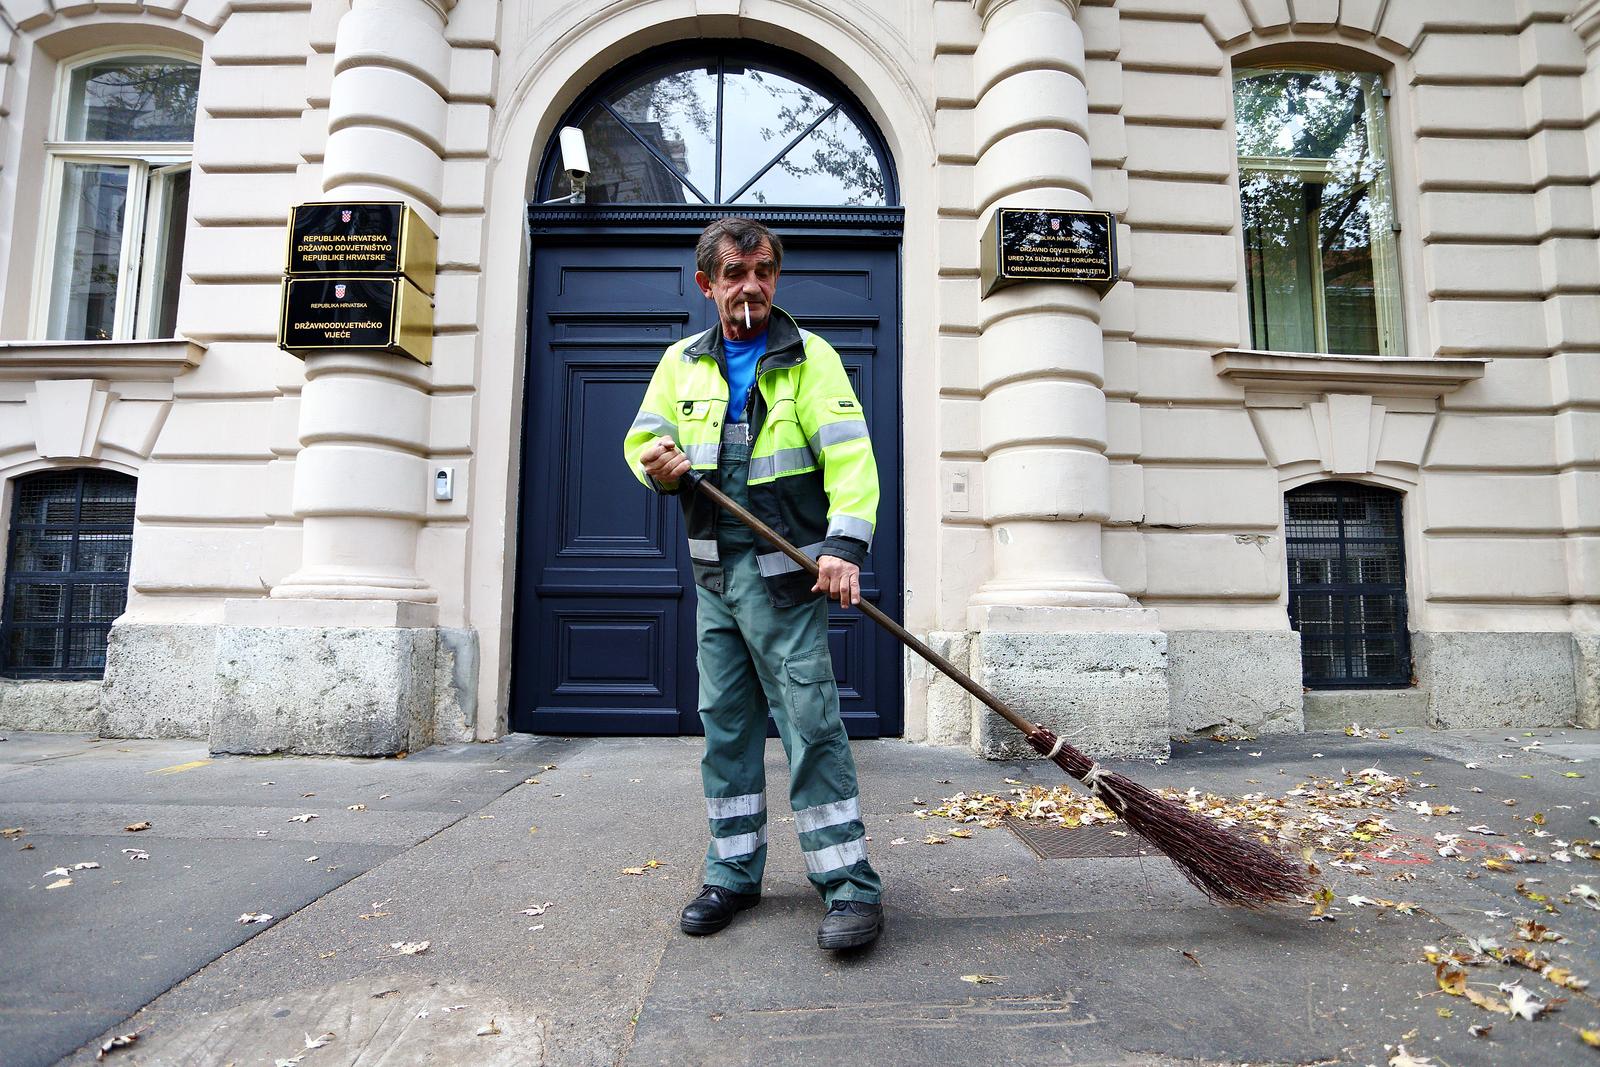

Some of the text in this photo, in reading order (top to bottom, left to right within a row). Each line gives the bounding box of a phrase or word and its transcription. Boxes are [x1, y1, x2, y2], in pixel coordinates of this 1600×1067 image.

[347, 234, 388, 242] HRVATSKA
[297, 243, 392, 252] DRŽAVNO ODVJETNIŠTVO
[346, 253, 386, 261] HRVATSKE
[294, 320, 383, 330] DRŽAVNOODVJETNIČKO
[324, 330, 351, 338] VIJEĆE
